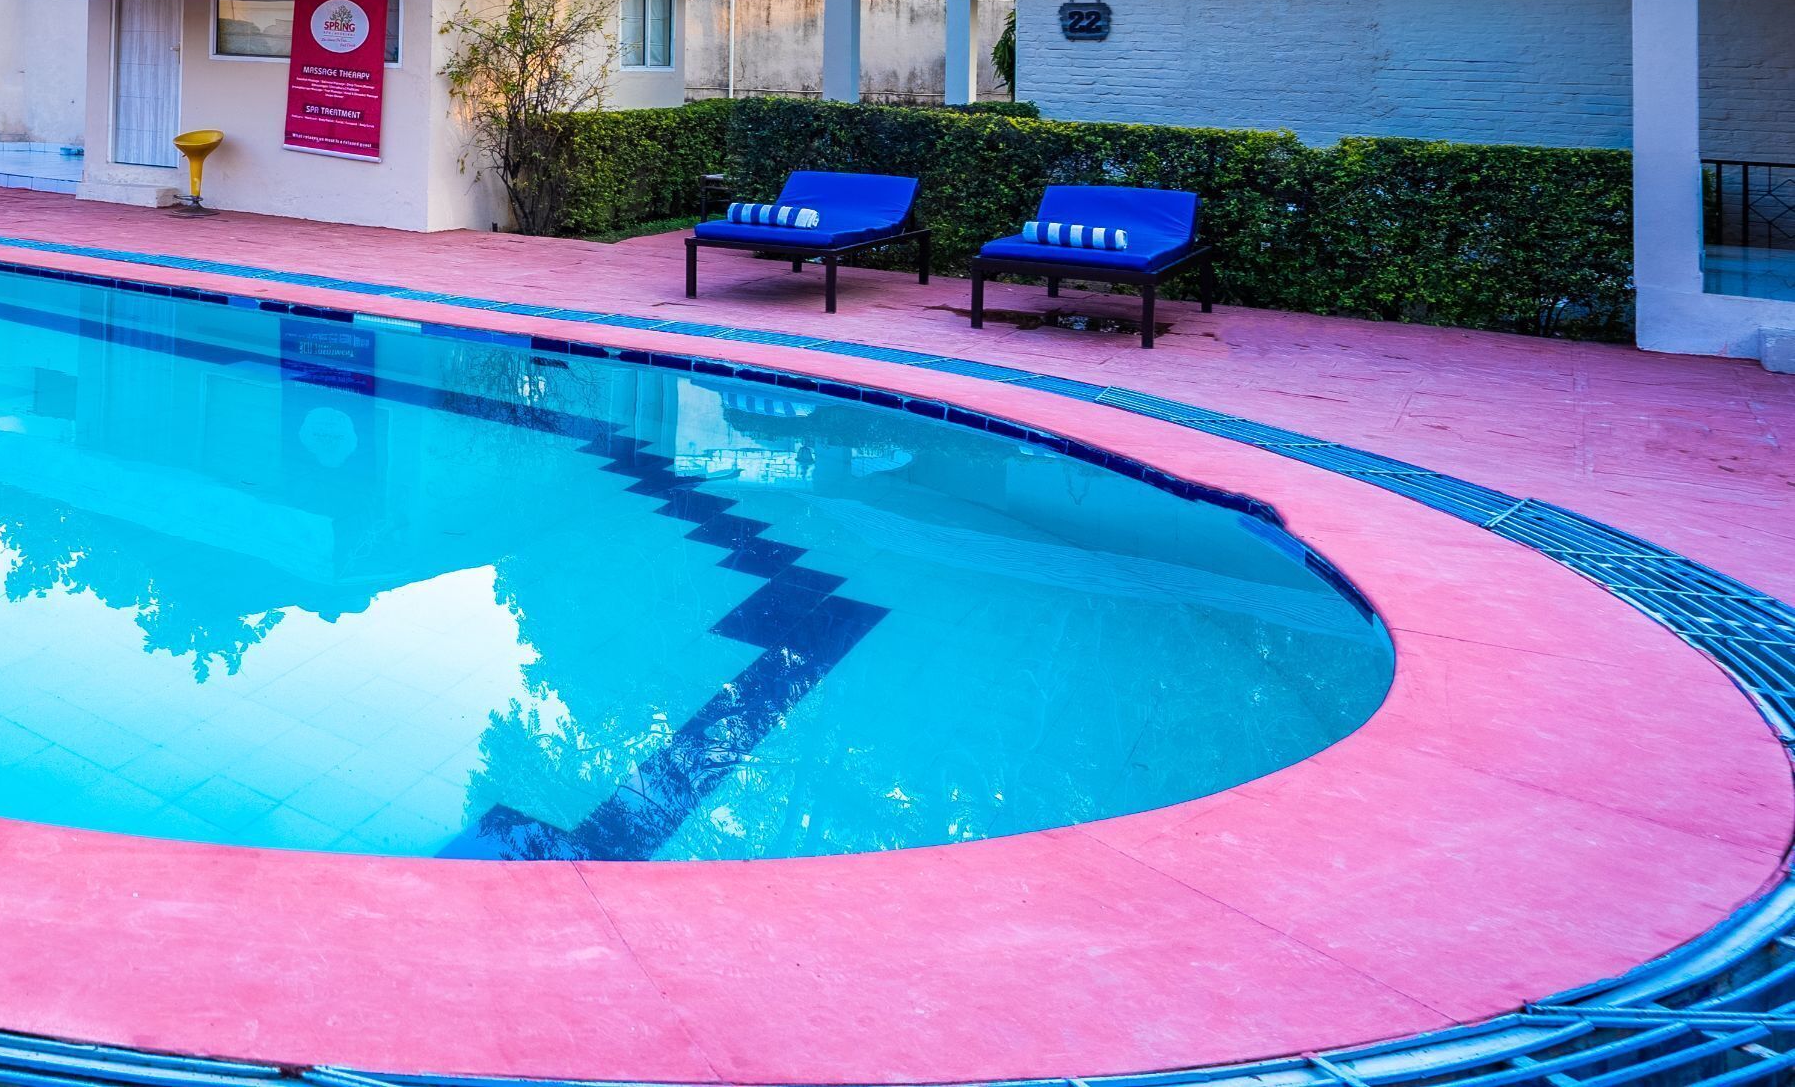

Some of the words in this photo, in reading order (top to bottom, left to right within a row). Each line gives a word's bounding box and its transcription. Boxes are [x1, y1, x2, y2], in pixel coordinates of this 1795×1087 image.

[324, 20, 356, 32] SPRING
[1068, 10, 1101, 34] 22
[303, 66, 338, 77] MASSAGE
[339, 69, 370, 80] THERAPY
[306, 105, 319, 114] SPA
[320, 107, 360, 119] TREATMENT
